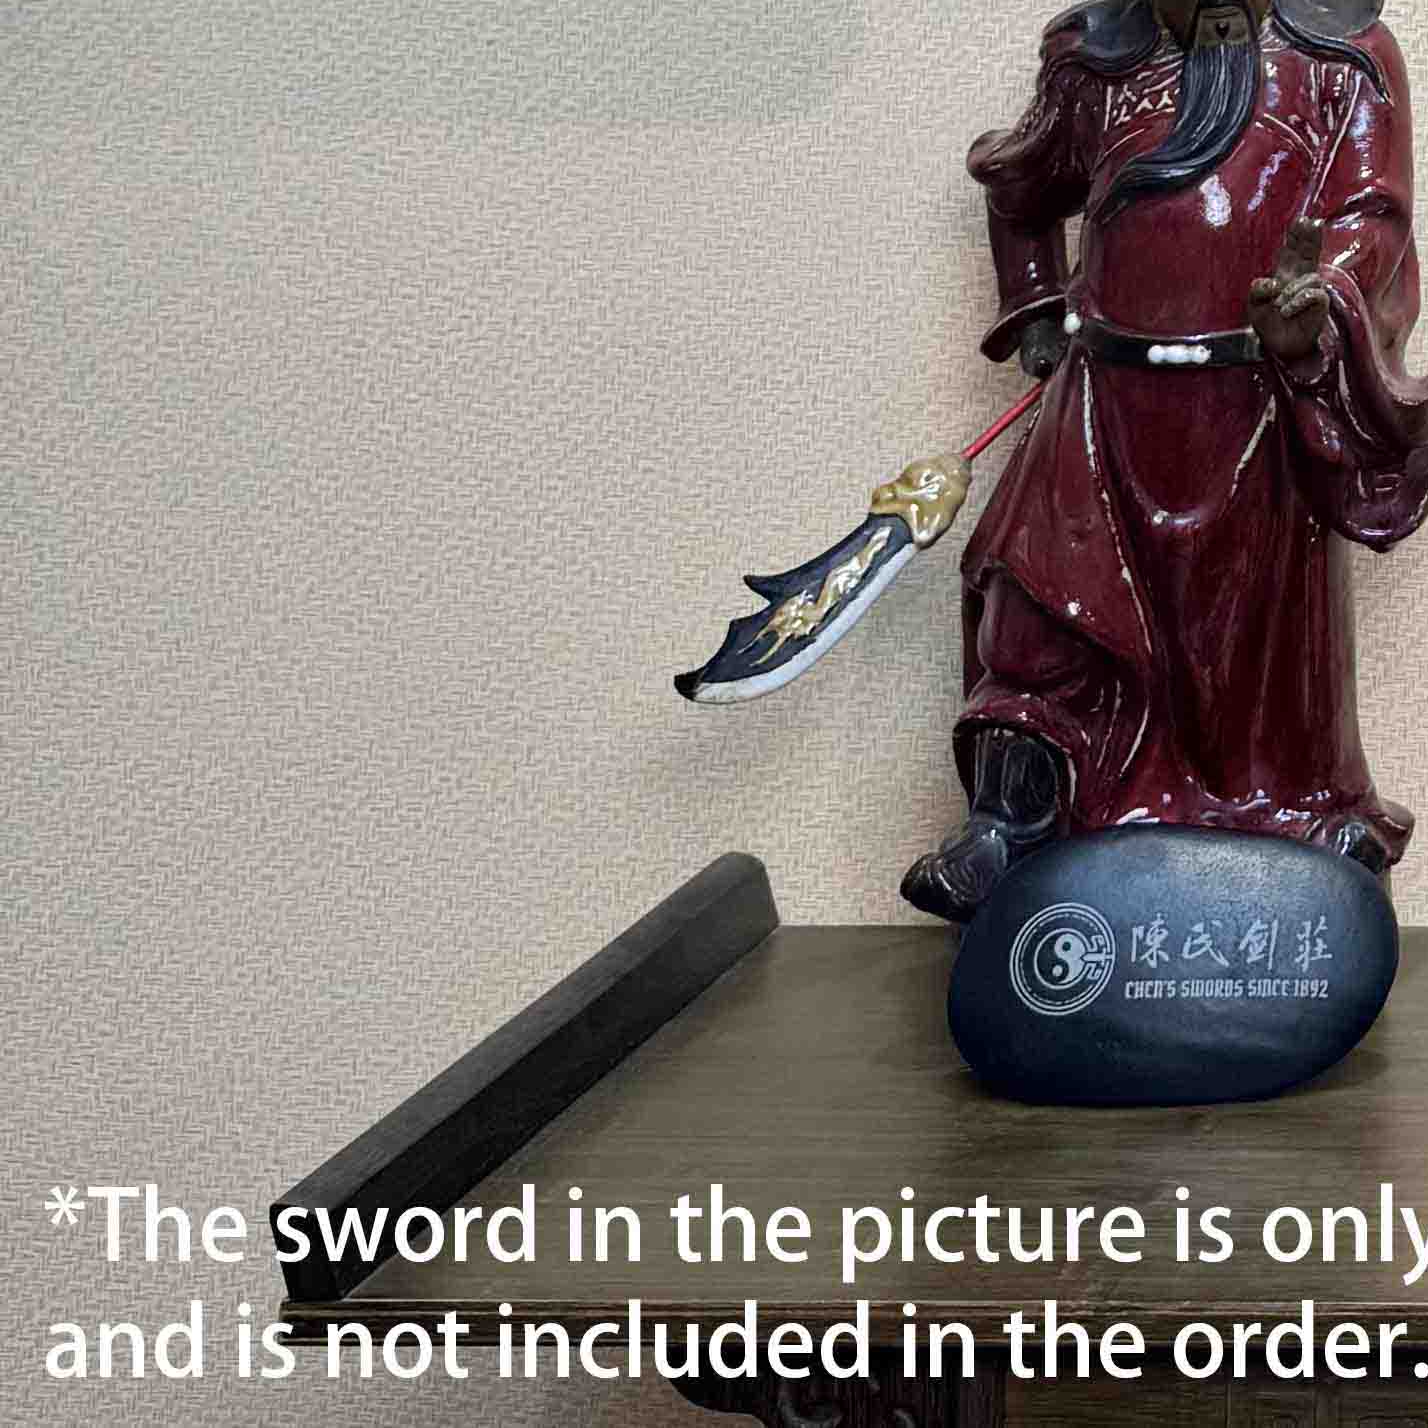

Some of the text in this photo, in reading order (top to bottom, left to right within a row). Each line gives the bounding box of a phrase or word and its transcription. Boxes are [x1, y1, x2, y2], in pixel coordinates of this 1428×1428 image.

[1124, 978, 1329, 999] CHEN'S SWORDS SINCE 1892
